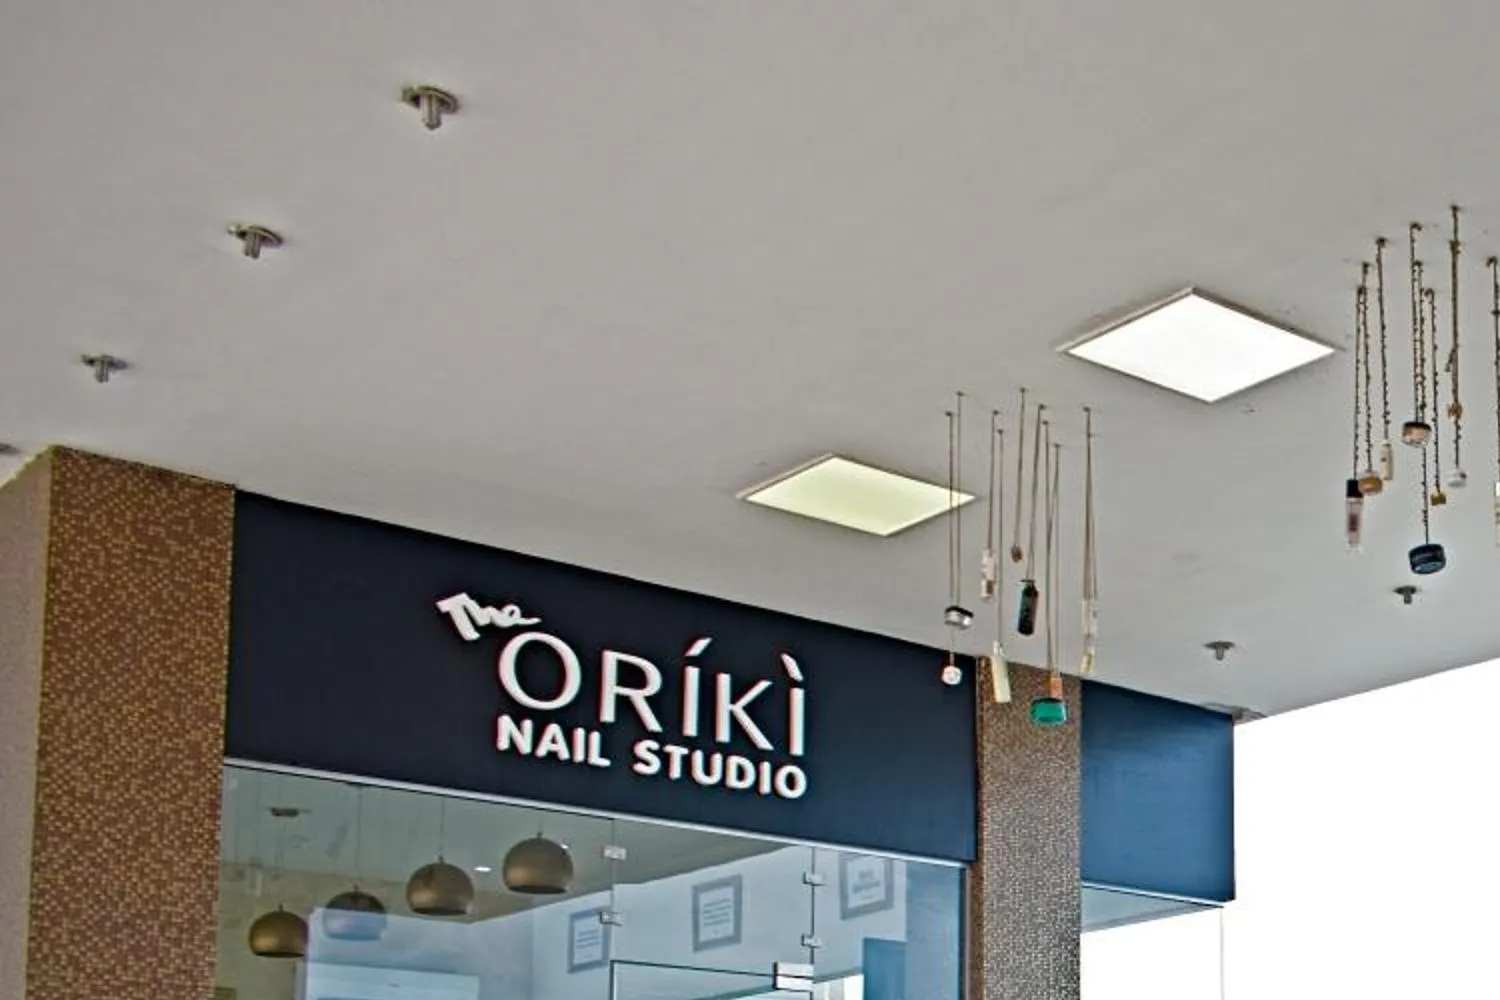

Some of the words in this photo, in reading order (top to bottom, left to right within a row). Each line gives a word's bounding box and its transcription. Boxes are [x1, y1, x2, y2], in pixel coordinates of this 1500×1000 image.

[435, 592, 542, 641] The
[498, 631, 805, 757] ORÍKÌ
[496, 714, 611, 767] NAIL
[633, 740, 808, 799] STUDIO
